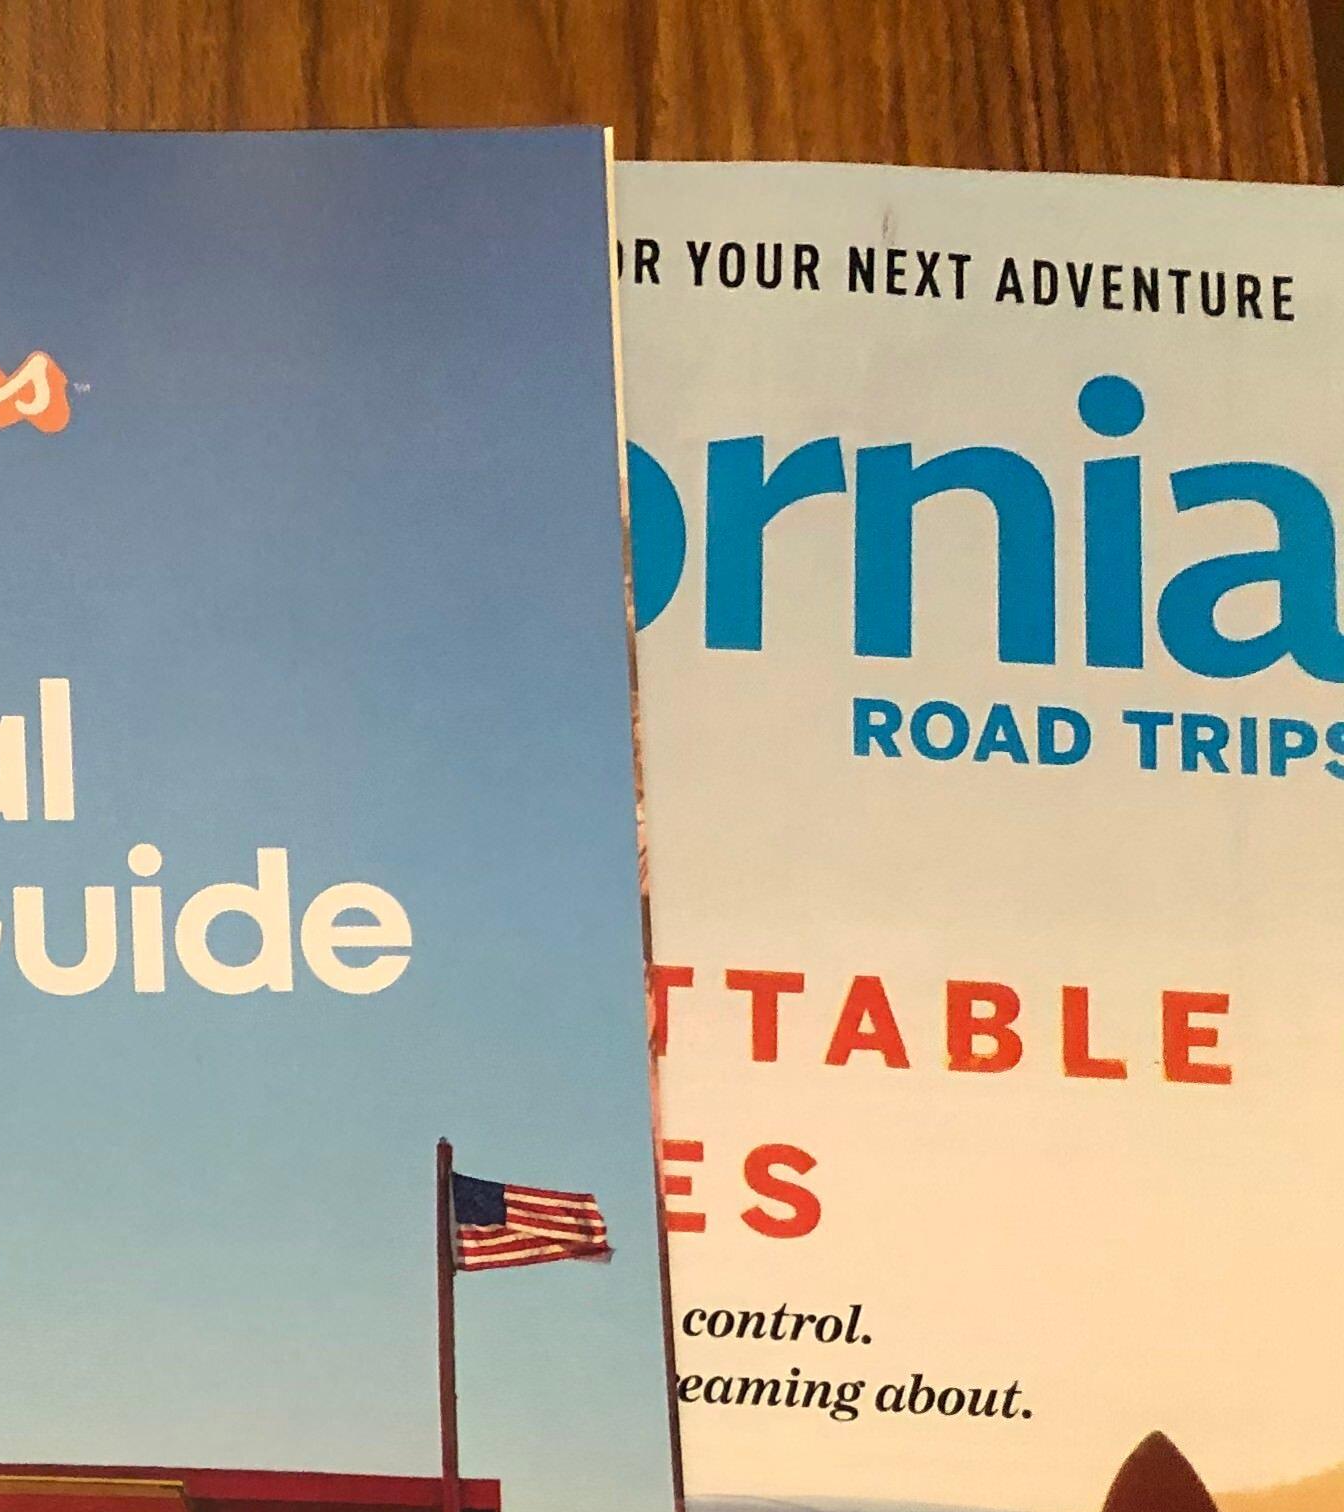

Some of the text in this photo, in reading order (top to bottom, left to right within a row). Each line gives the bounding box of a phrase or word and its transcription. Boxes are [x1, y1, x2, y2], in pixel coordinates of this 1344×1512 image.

[686, 241, 820, 290] YOUR
[848, 247, 972, 300] NEXT
[996, 257, 1296, 321] ADVENTURE
[853, 697, 1092, 766] ROAD
[663, 1139, 821, 1239] ES
[682, 1303, 872, 1345] control.
[676, 1367, 1033, 1422] eaming about.
